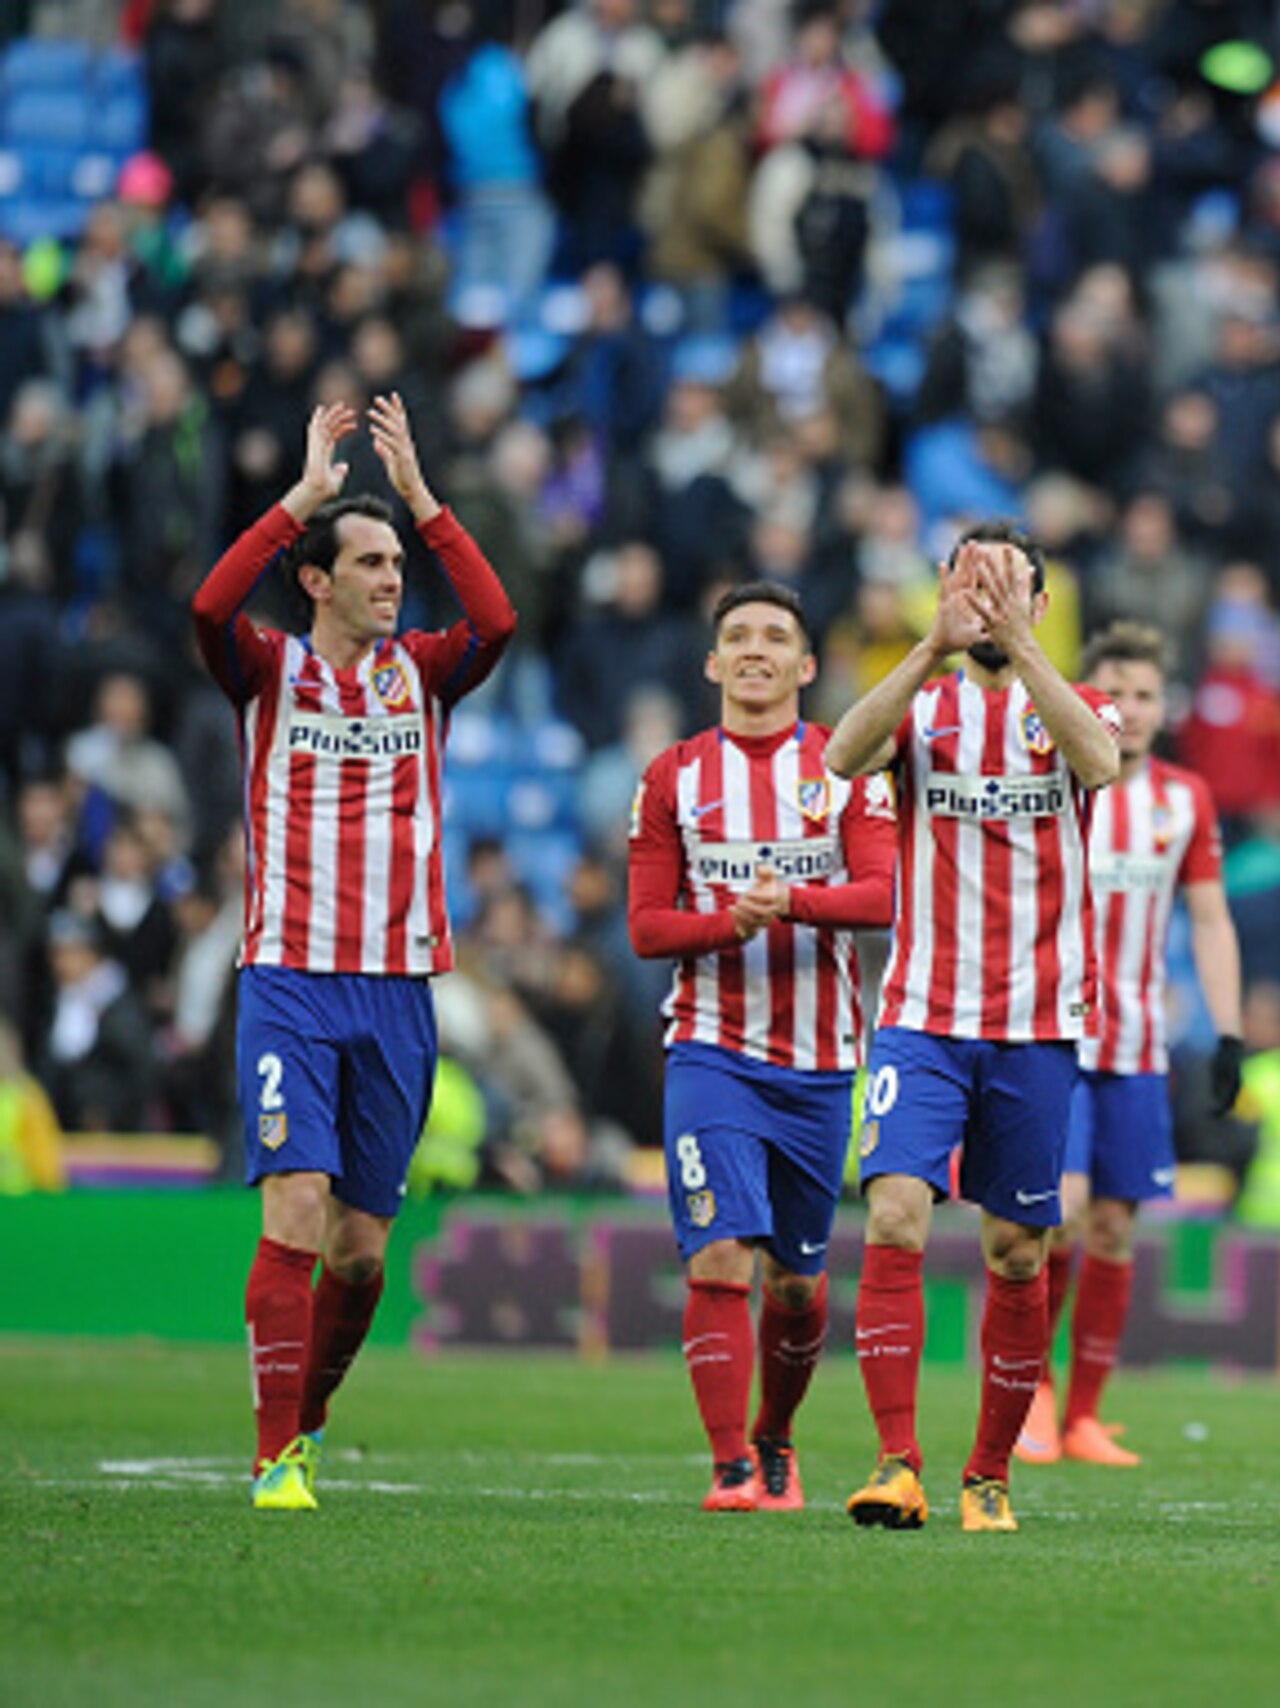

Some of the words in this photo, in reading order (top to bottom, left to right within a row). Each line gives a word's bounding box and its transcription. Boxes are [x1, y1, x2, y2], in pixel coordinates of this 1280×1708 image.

[926, 788, 1063, 815] Plus500
[700, 851, 836, 879] Plu500
[257, 1052, 283, 1110] 2
[676, 1133, 706, 1189] 8
